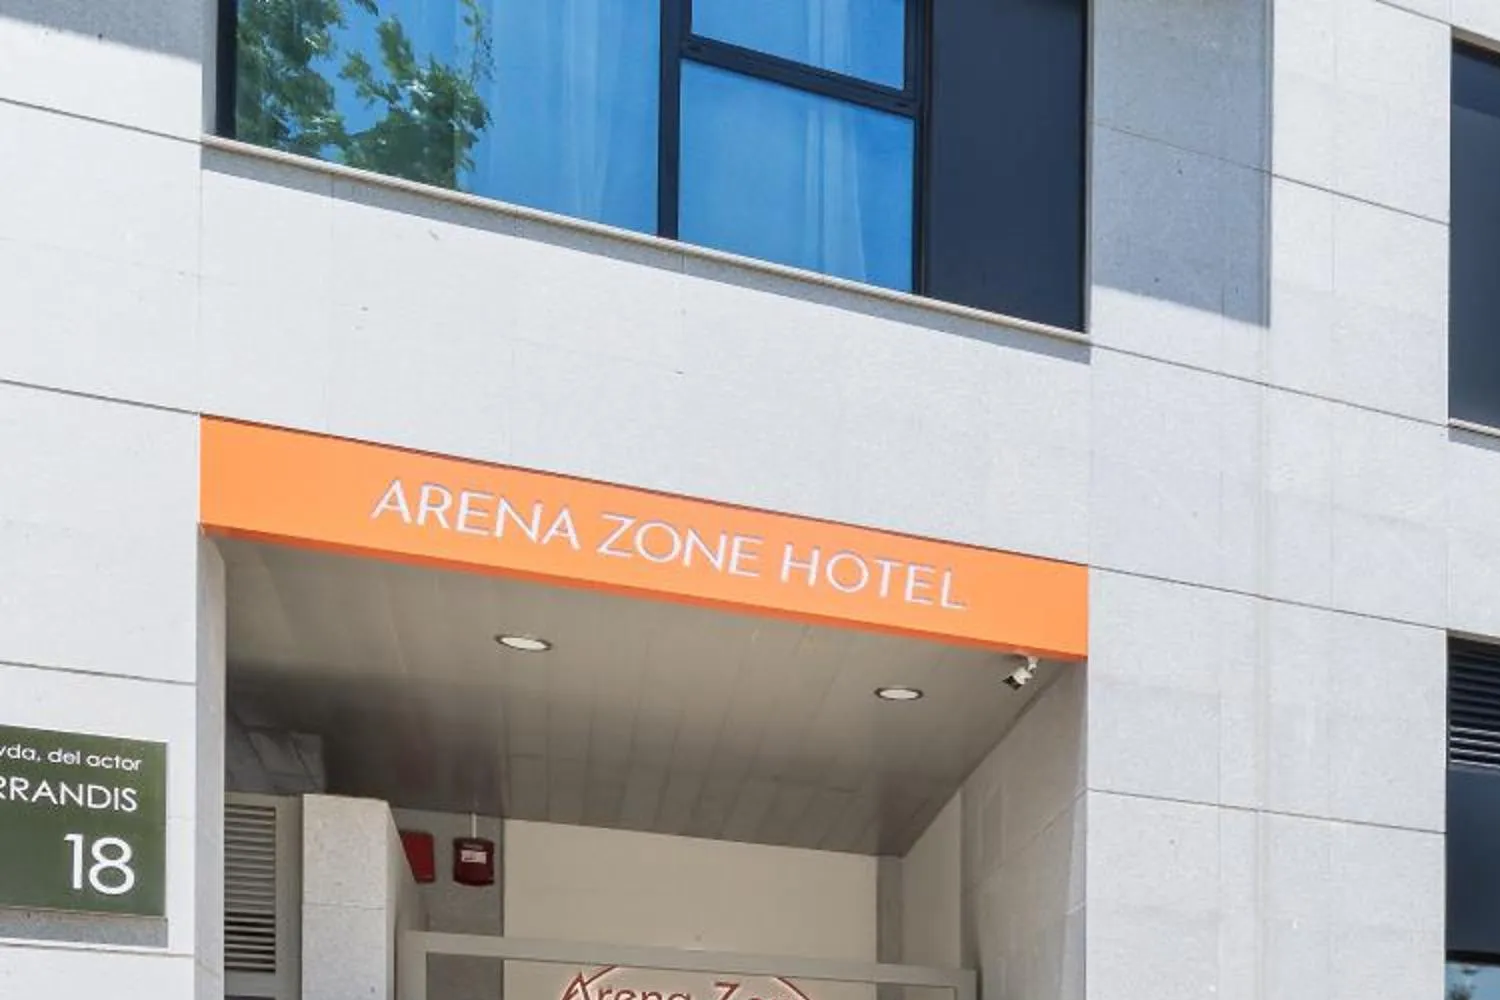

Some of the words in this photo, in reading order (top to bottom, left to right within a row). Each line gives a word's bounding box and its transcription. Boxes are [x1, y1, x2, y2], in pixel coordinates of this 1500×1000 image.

[372, 479, 580, 550] ARENA
[597, 512, 761, 578] ZONE
[780, 543, 967, 611] HOTEL
[47, 748, 81, 765] del
[86, 755, 142, 771] actor
[63, 833, 135, 895] 18
